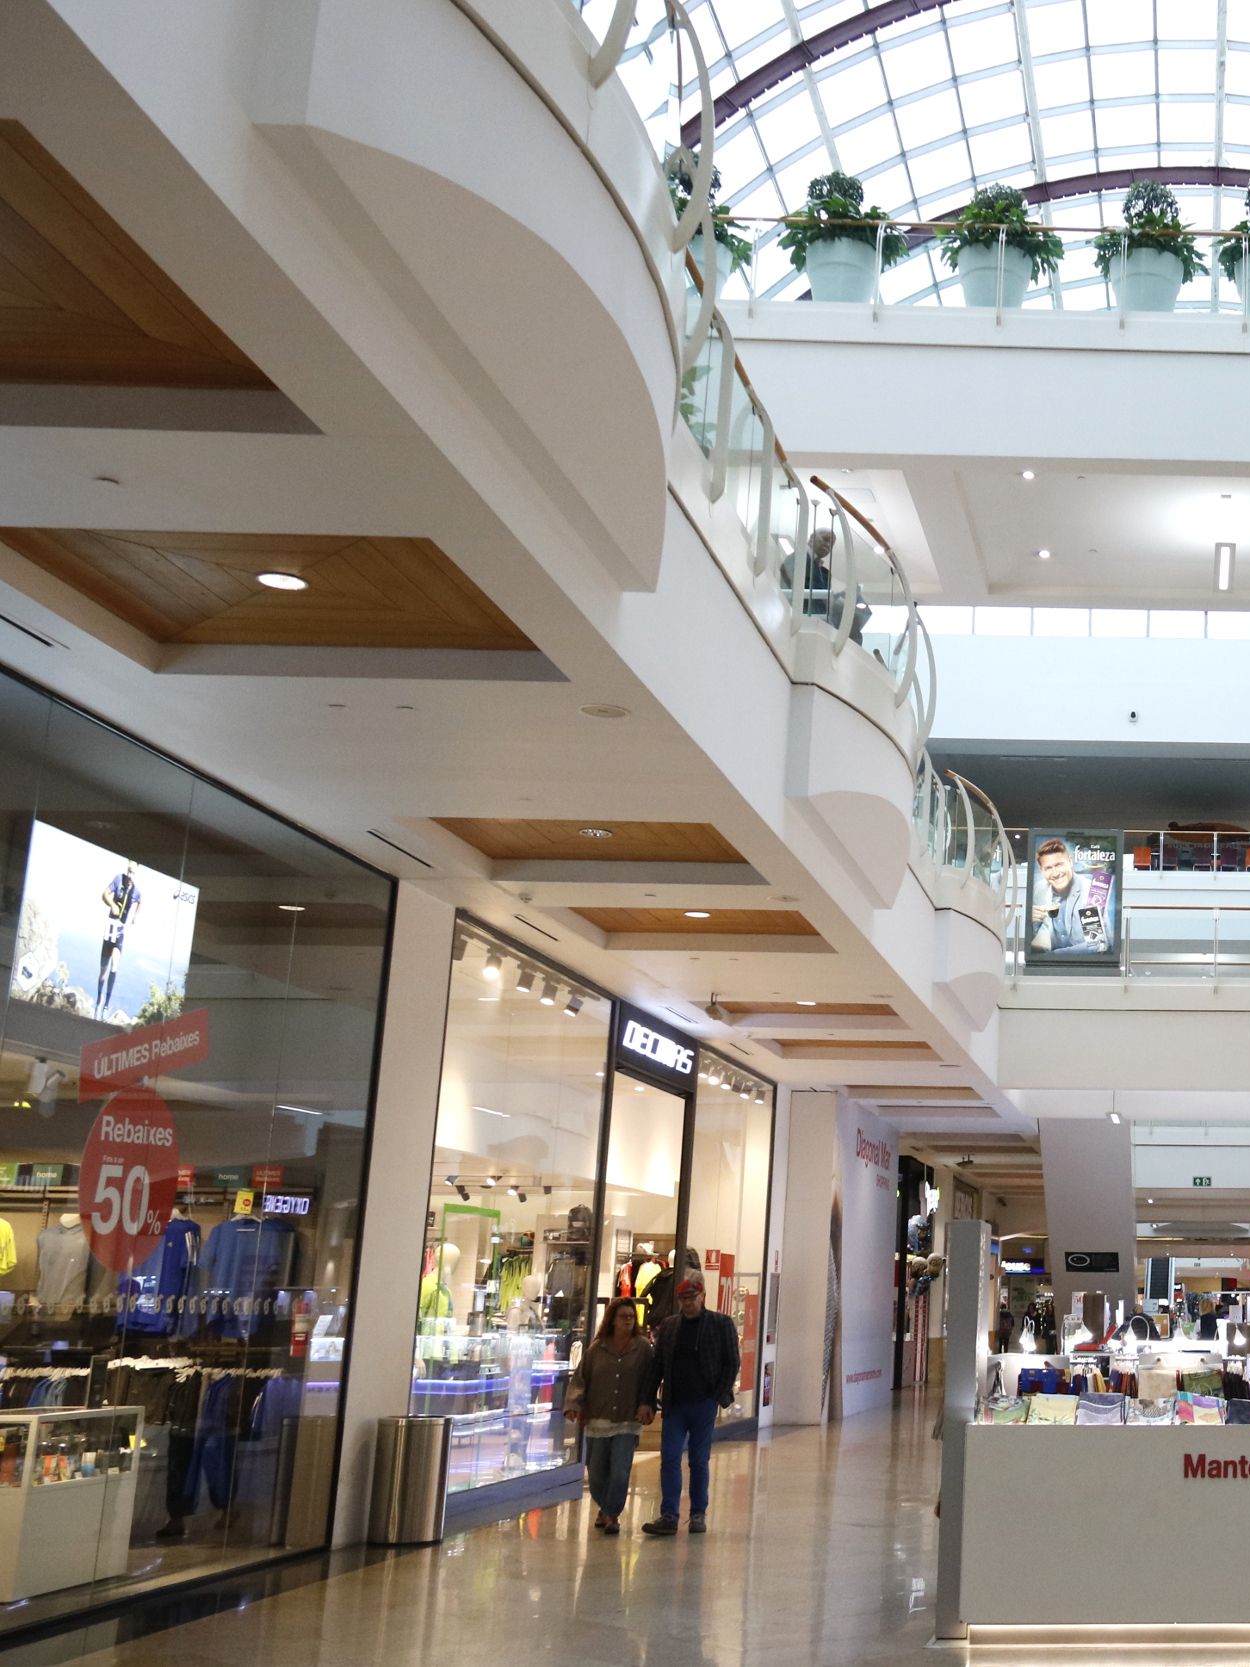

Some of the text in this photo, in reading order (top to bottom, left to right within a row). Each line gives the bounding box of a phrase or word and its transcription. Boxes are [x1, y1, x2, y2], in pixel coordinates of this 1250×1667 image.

[1074, 845, 1116, 863] fortaleza
[152, 1030, 200, 1060] Rebaixes
[101, 1115, 173, 1147] Rebaixes
[218, 1173, 240, 1181] home
